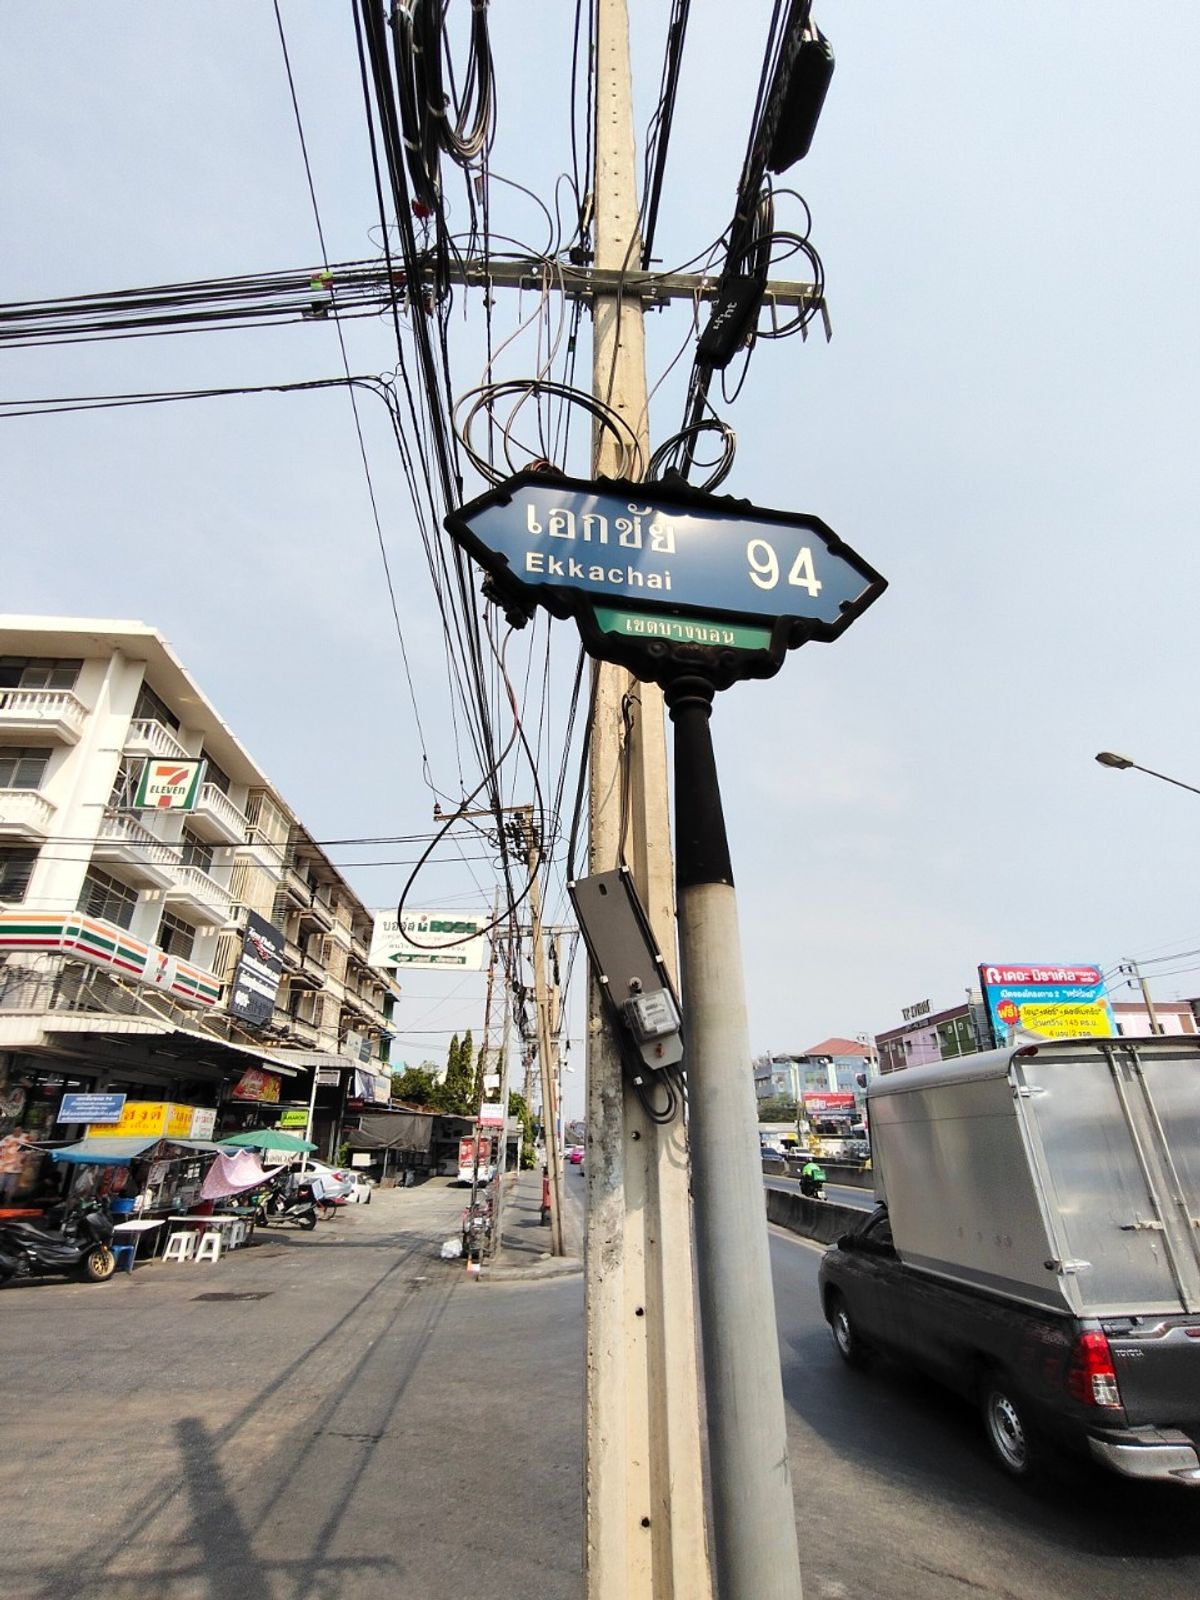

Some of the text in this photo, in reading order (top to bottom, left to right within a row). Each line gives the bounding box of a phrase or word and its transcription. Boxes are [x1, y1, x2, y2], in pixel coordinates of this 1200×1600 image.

[527, 503, 677, 554] เอกชัย
[526, 552, 672, 591] Ekkachai
[746, 538, 823, 598] 94
[626, 617, 735, 645] เขตบางบอน
[1115, 1348, 1145, 1358] TOYOTA
